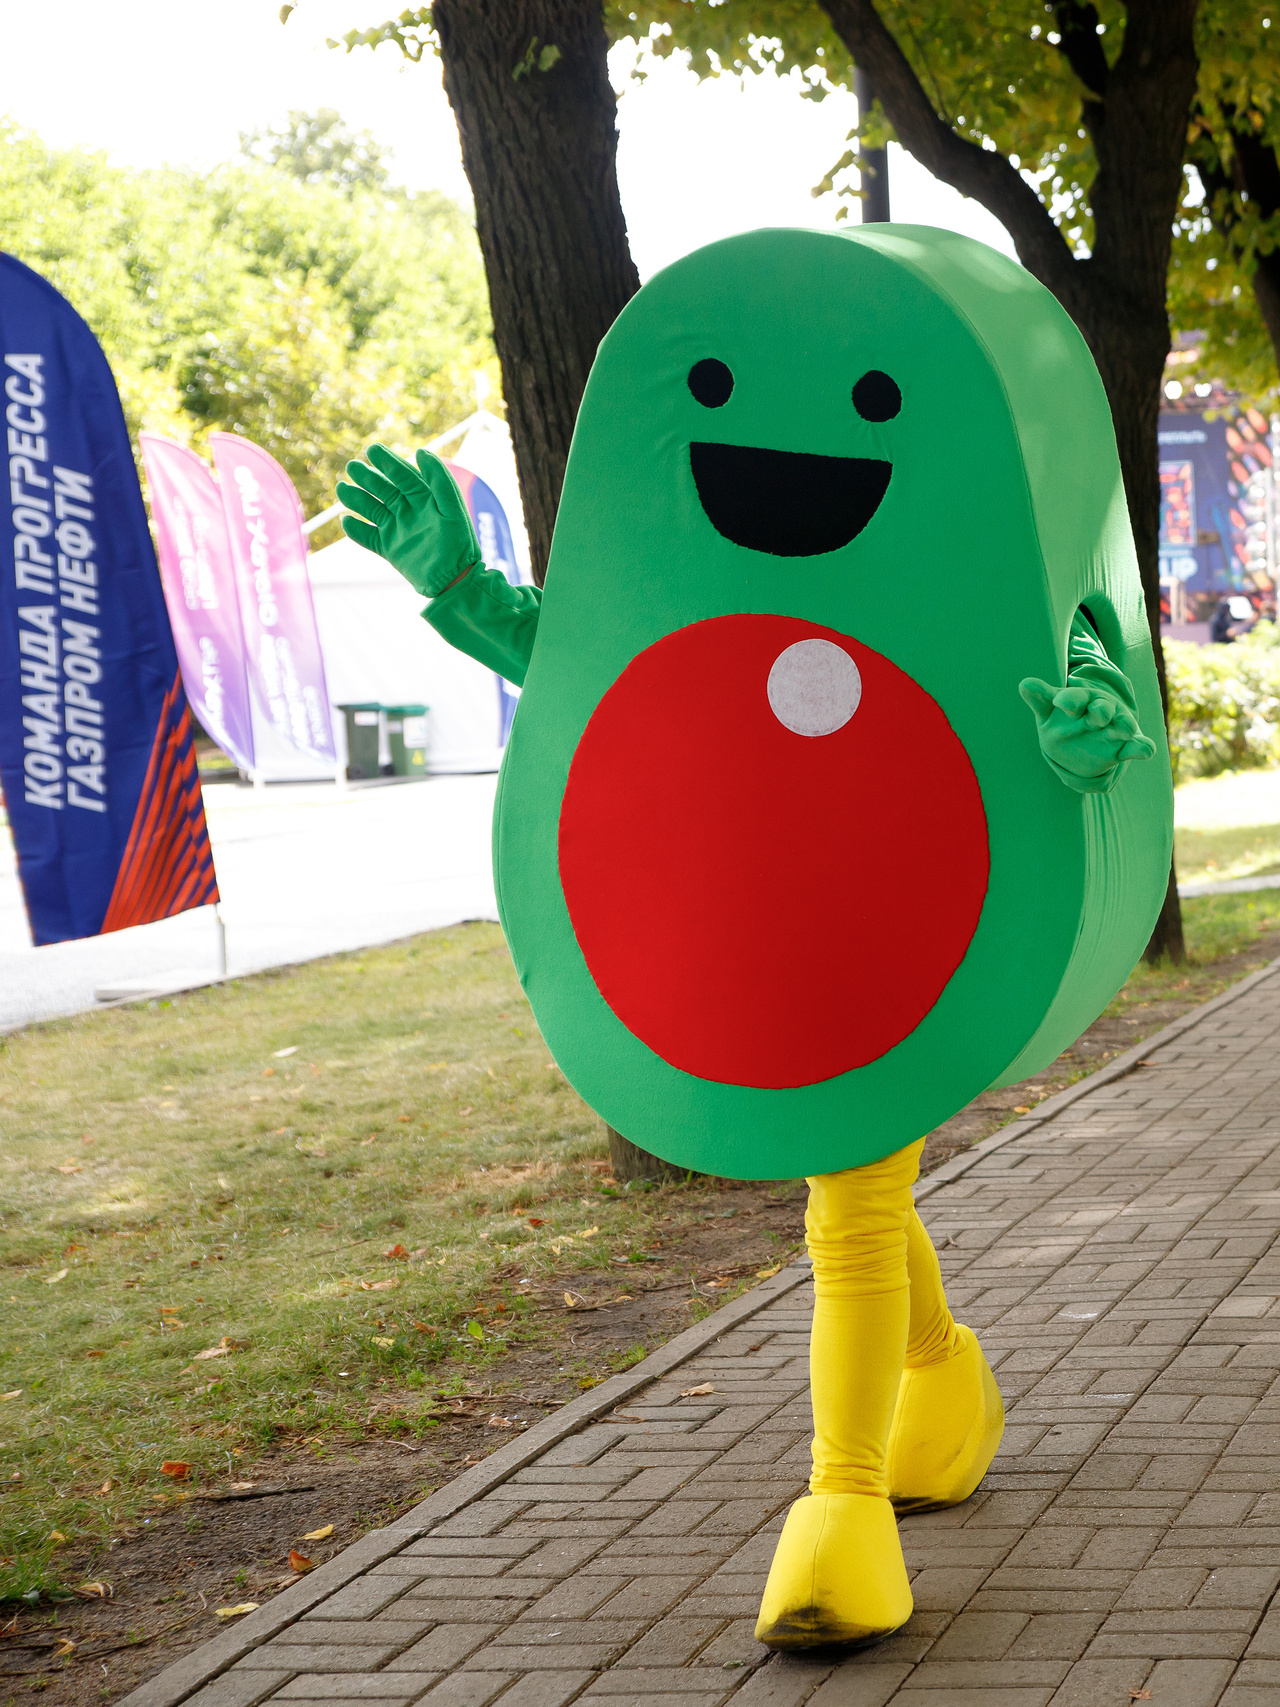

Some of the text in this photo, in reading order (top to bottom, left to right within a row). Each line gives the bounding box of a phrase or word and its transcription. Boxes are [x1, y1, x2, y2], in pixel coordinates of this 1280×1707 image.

[4, 353, 63, 810] КОМАНДА ПРОГРЕССА
[52, 465, 106, 813] ГАЗПРОМ НЕФТИ
